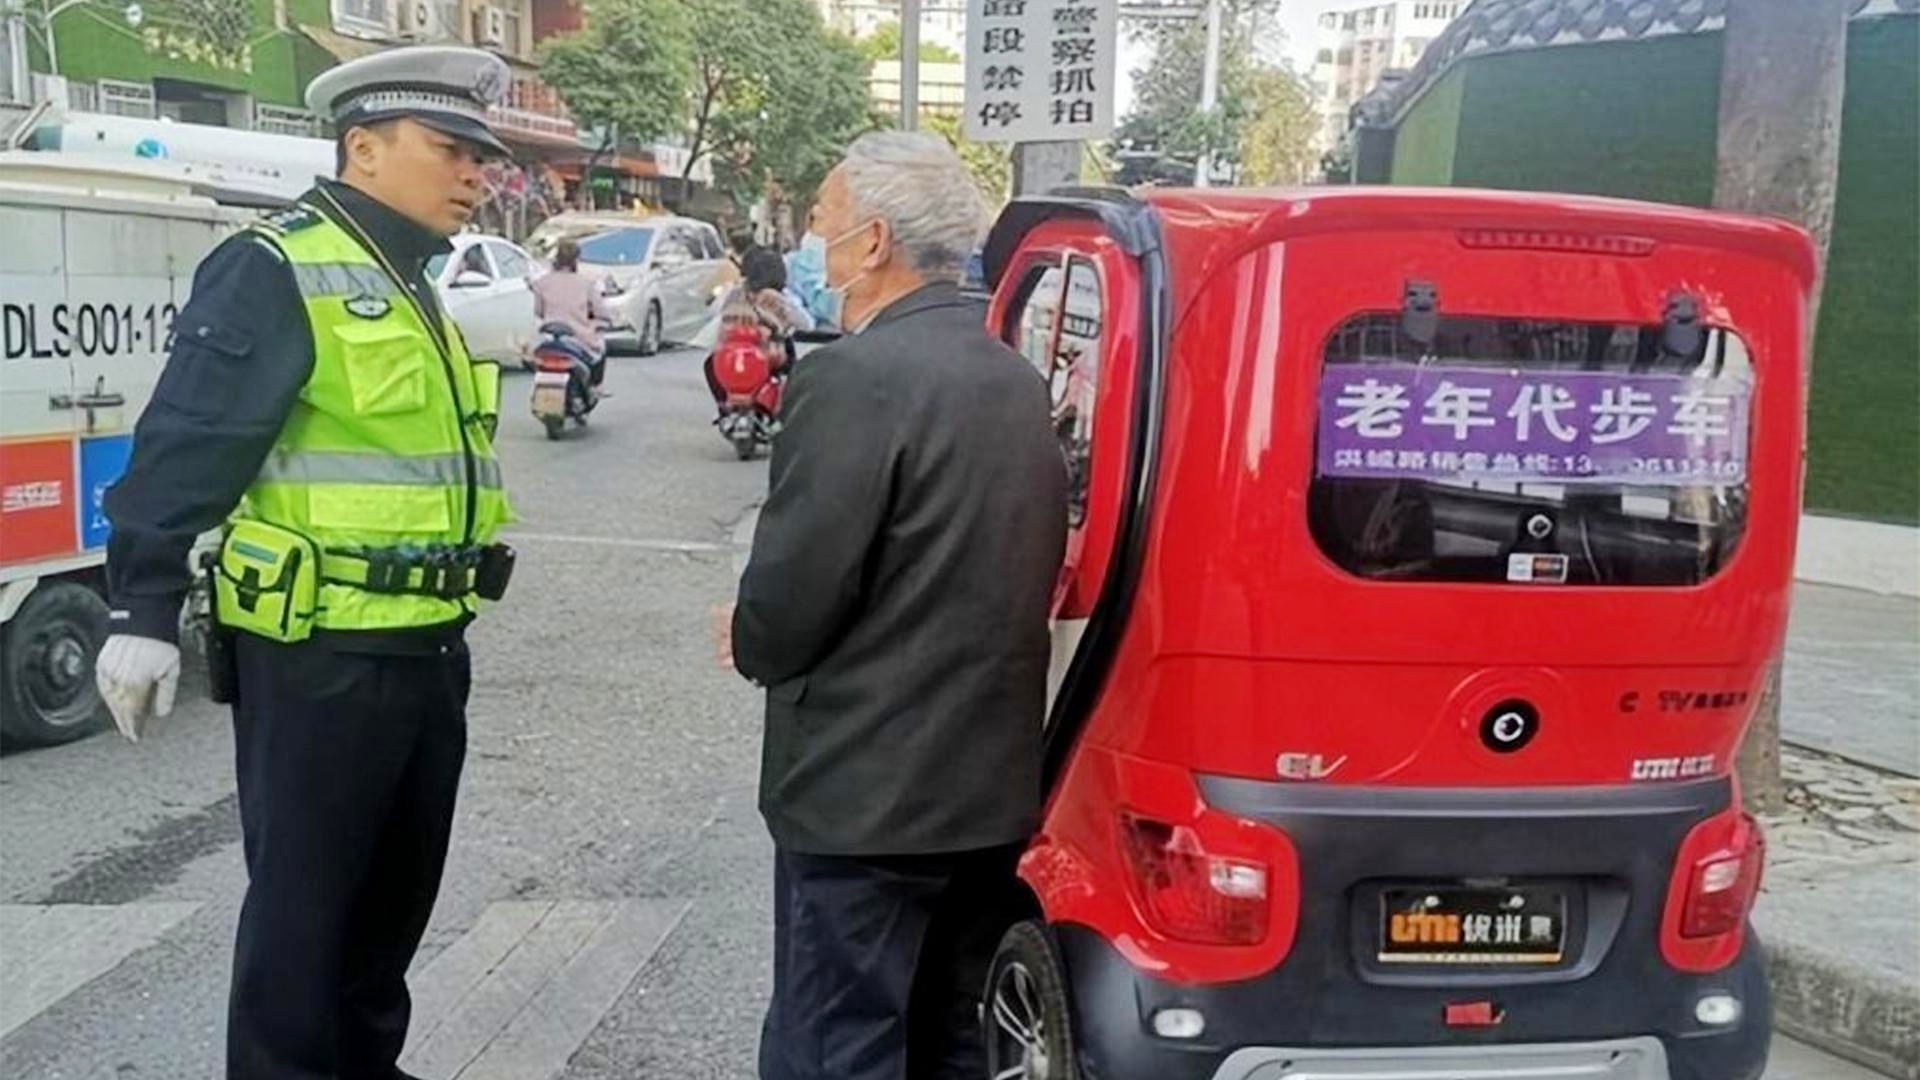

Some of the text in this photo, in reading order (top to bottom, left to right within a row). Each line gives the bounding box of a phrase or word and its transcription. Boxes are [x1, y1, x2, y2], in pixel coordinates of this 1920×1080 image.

[1050, 0, 1098, 125] 警察抓拍
[1334, 378, 1730, 446] 老年代步车
